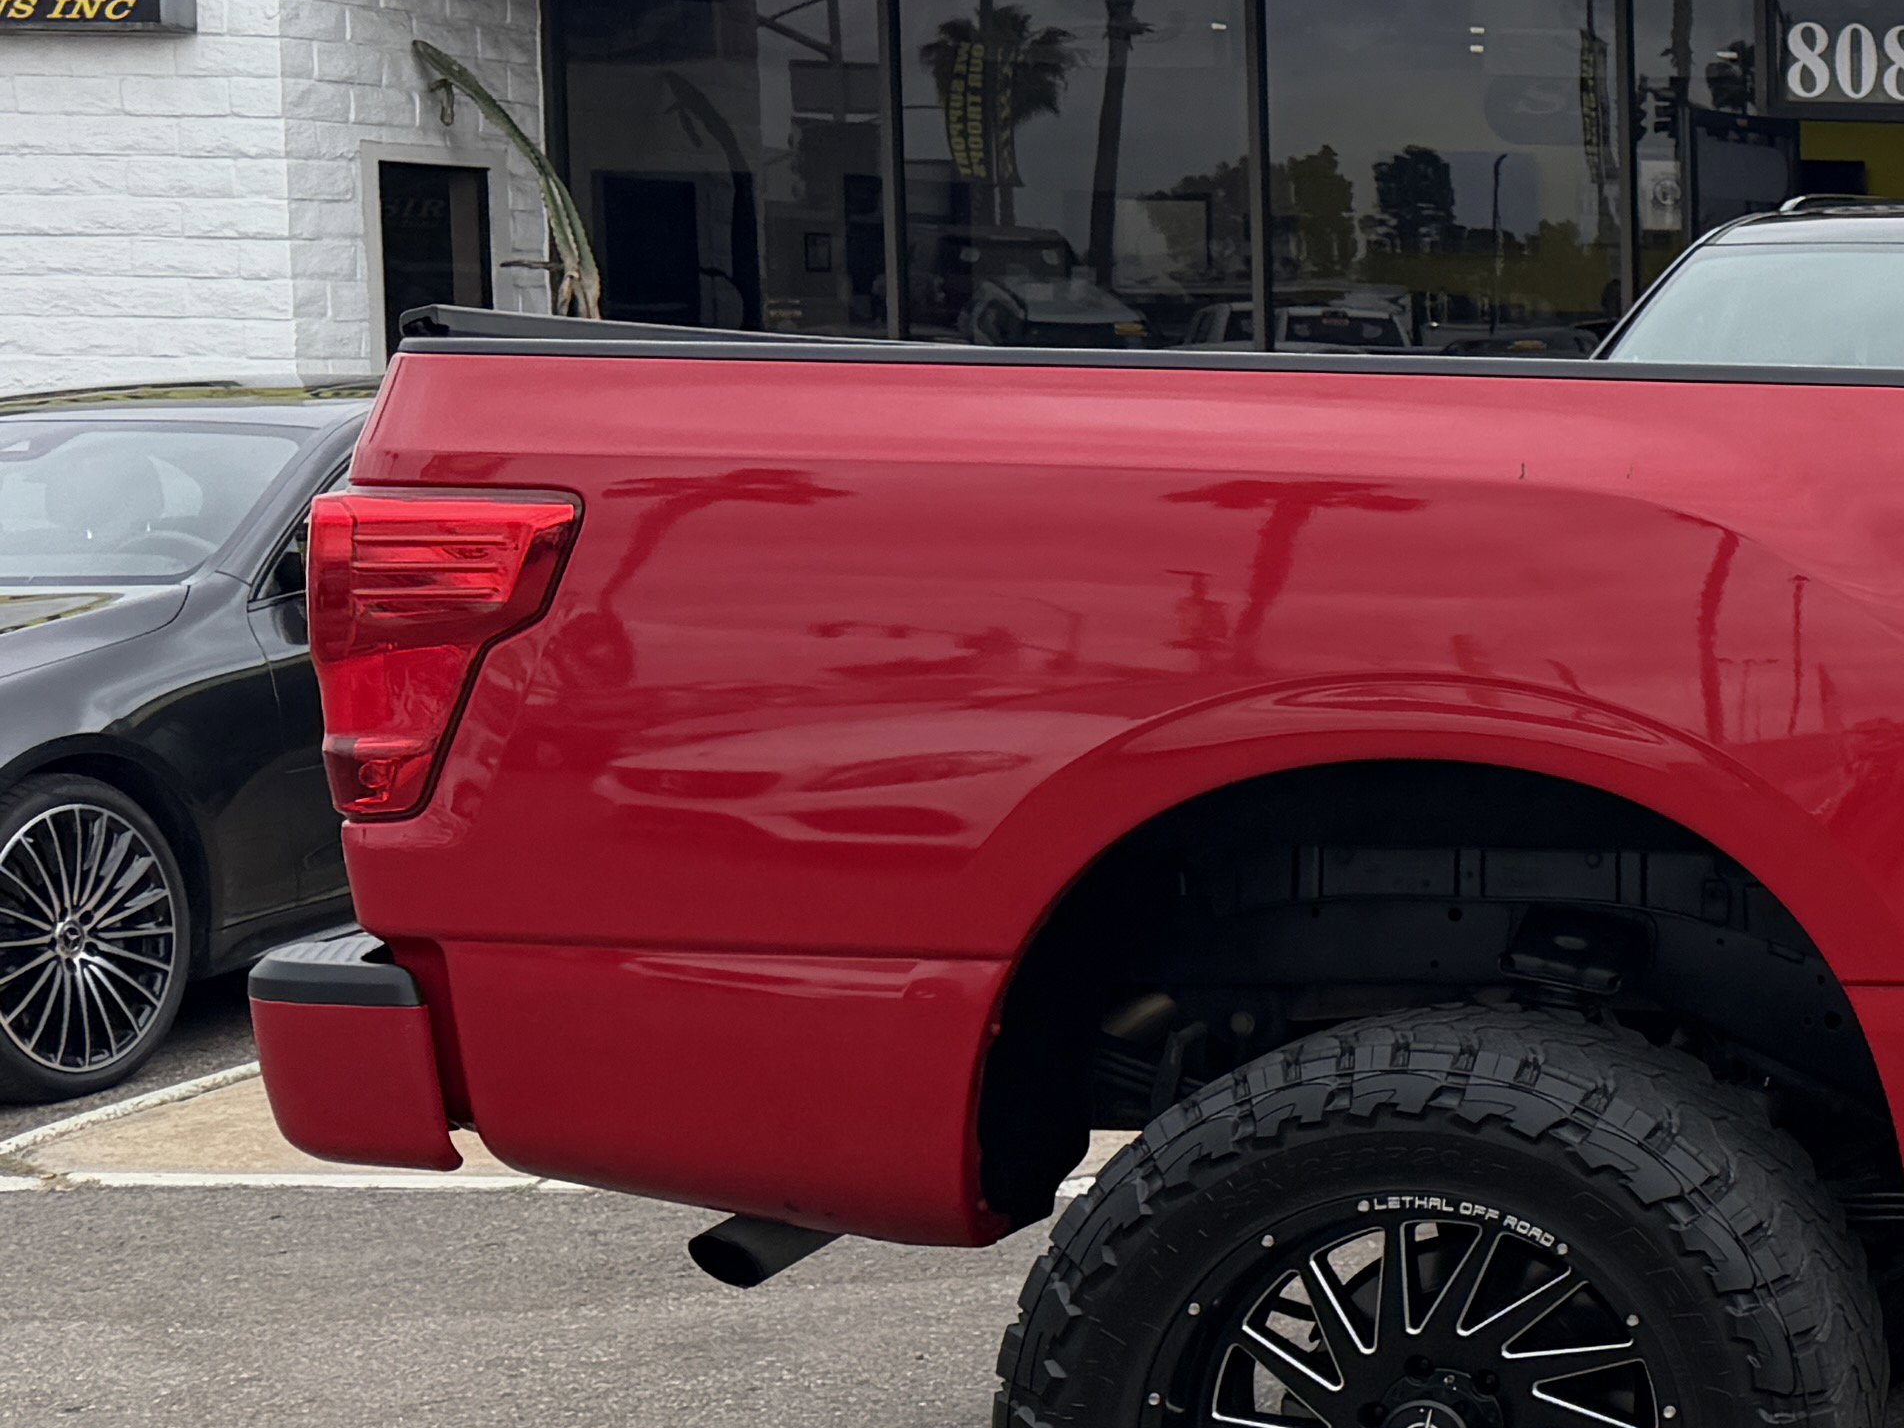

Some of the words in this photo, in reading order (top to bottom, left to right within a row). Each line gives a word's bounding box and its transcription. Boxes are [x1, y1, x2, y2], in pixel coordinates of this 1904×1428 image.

[1373, 1195, 1454, 1212] LETHAL
[1459, 1201, 1500, 1221] OFF
[1502, 1214, 1556, 1248] ROAD
